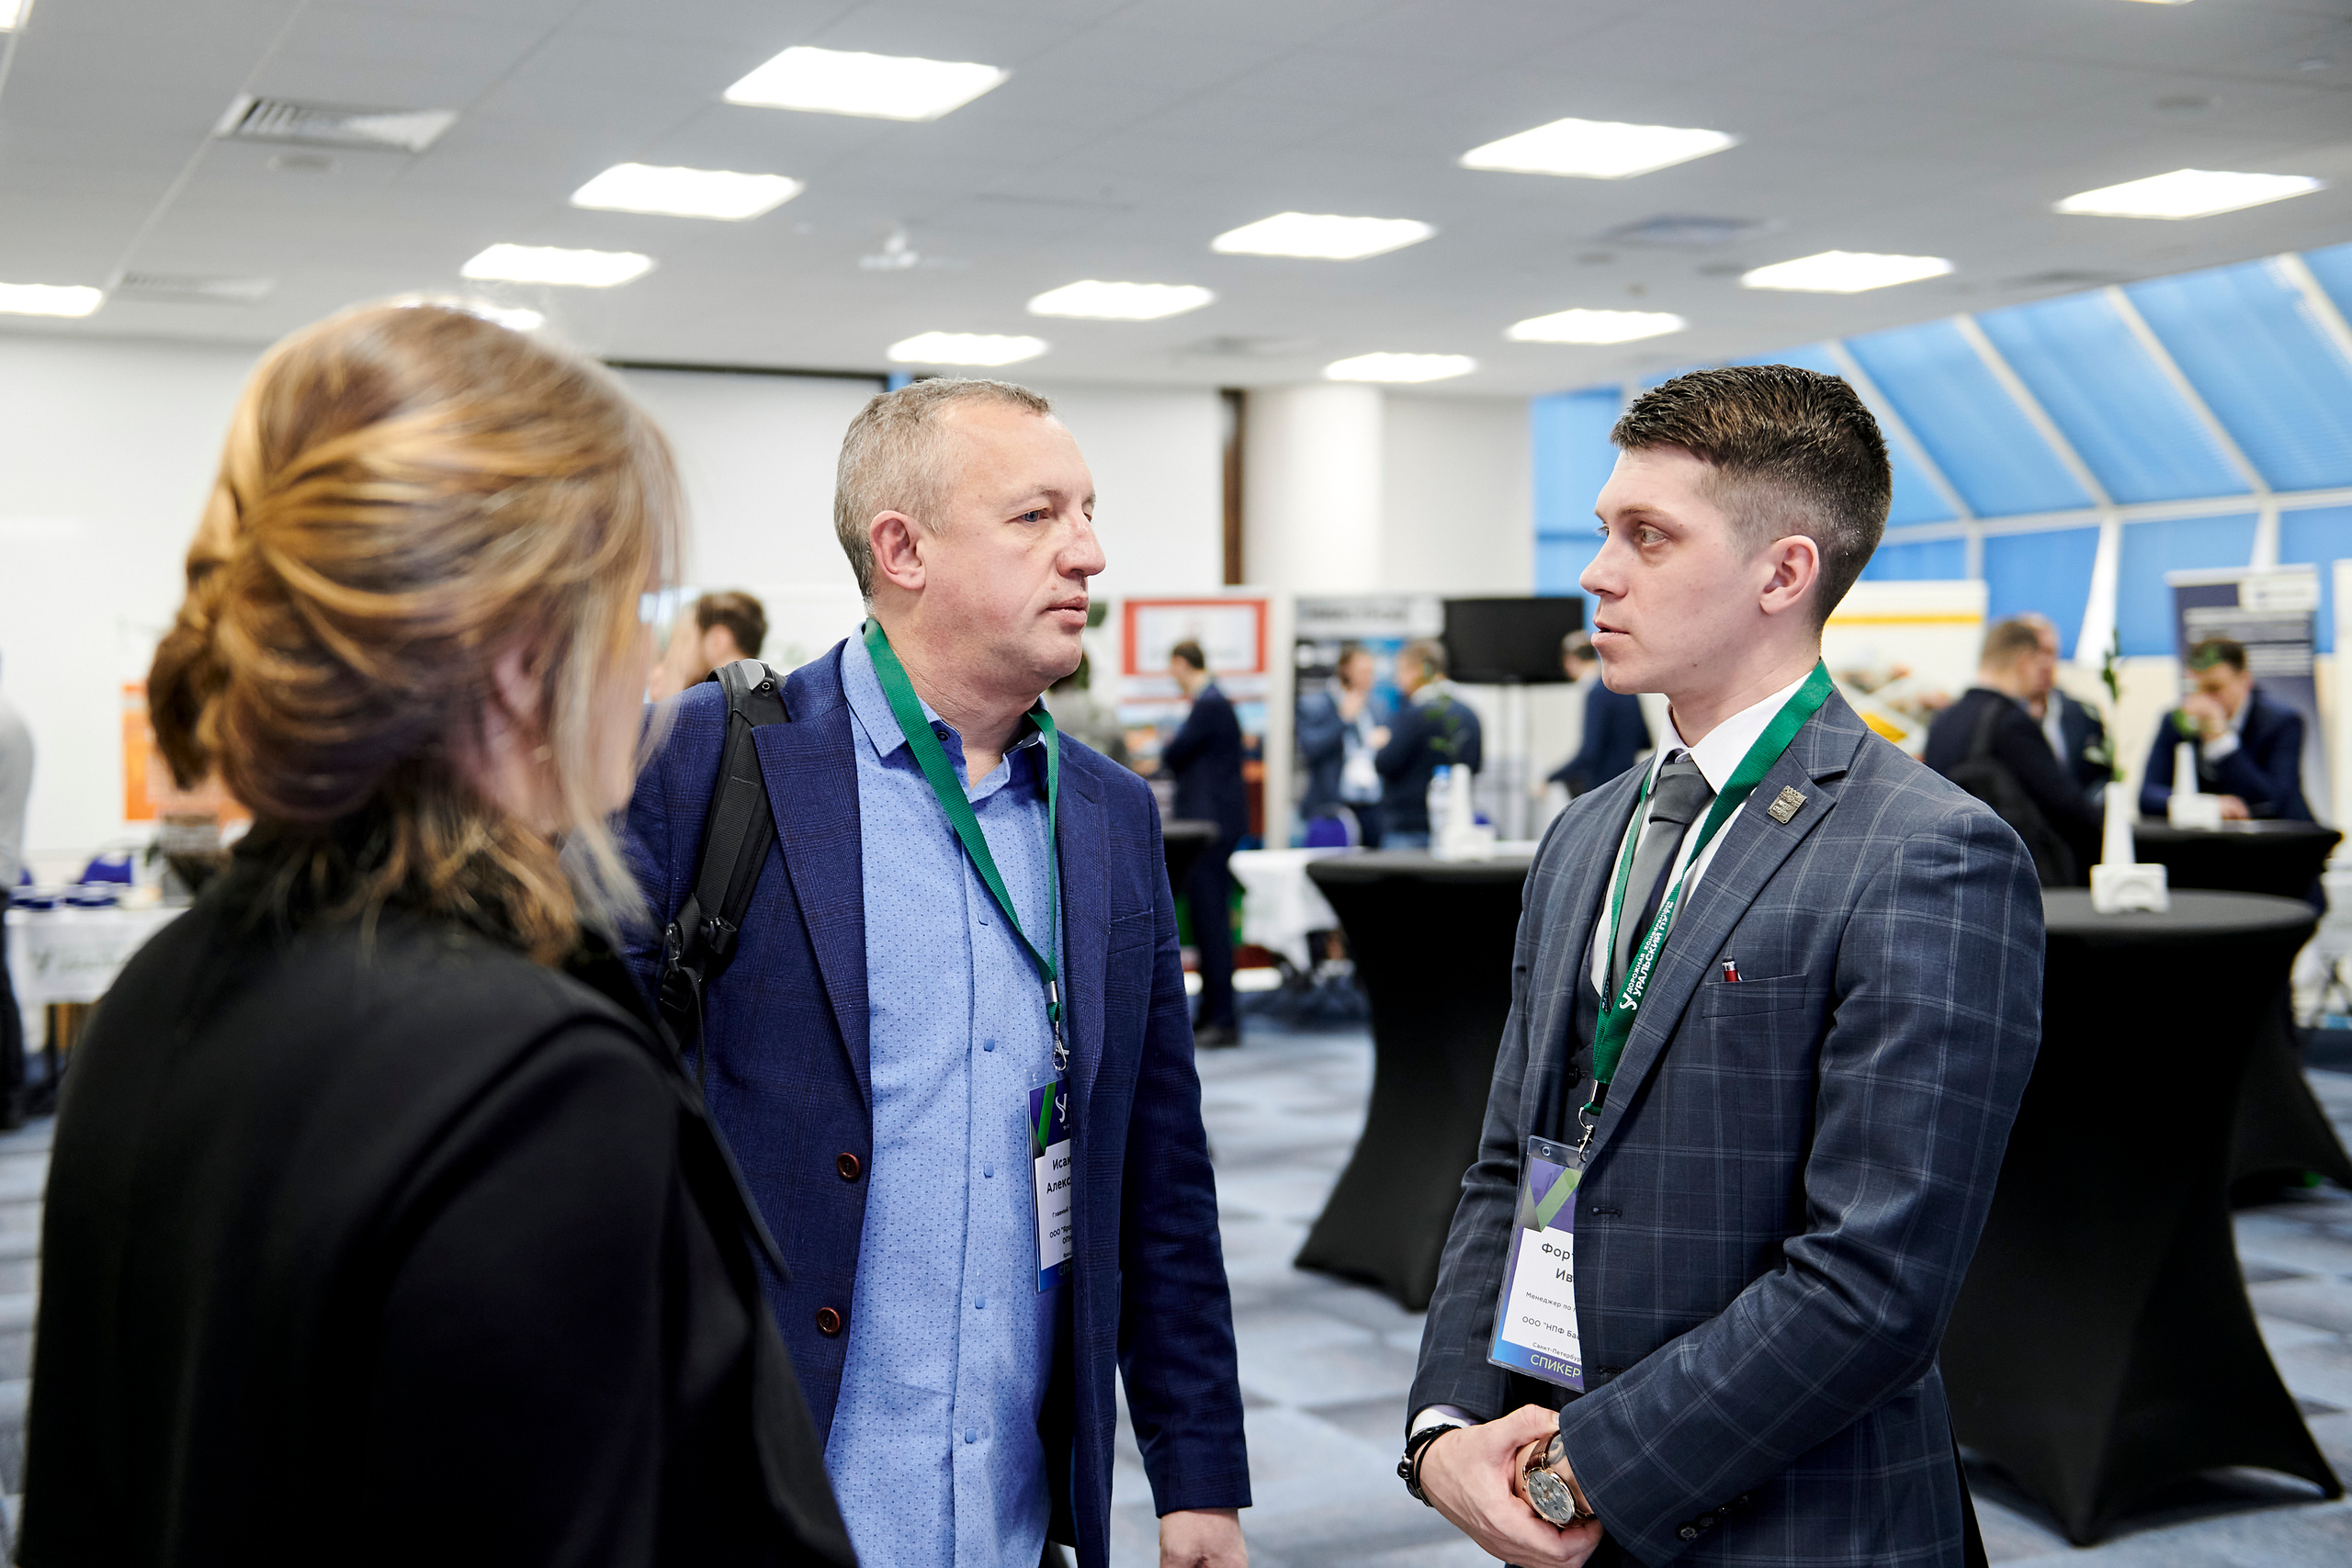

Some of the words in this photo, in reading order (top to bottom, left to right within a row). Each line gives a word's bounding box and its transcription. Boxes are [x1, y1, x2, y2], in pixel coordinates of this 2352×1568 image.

[1633, 931, 1663, 998] УРАЛЬСКИЙ
[1658, 901, 1674, 931] ПУТЬ
[1626, 953, 1645, 994] ДОРОЖНАЯ
[1049, 1228, 1060, 1238] ООО
[1541, 1243, 1574, 1261] Фор
[1525, 1292, 1562, 1308] Менеджер
[1563, 1303, 1572, 1312] по
[1521, 1315, 1542, 1327] ООО
[1543, 1322, 1565, 1334] "НПФ
[1530, 1354, 1581, 1378] СПИКЕР
